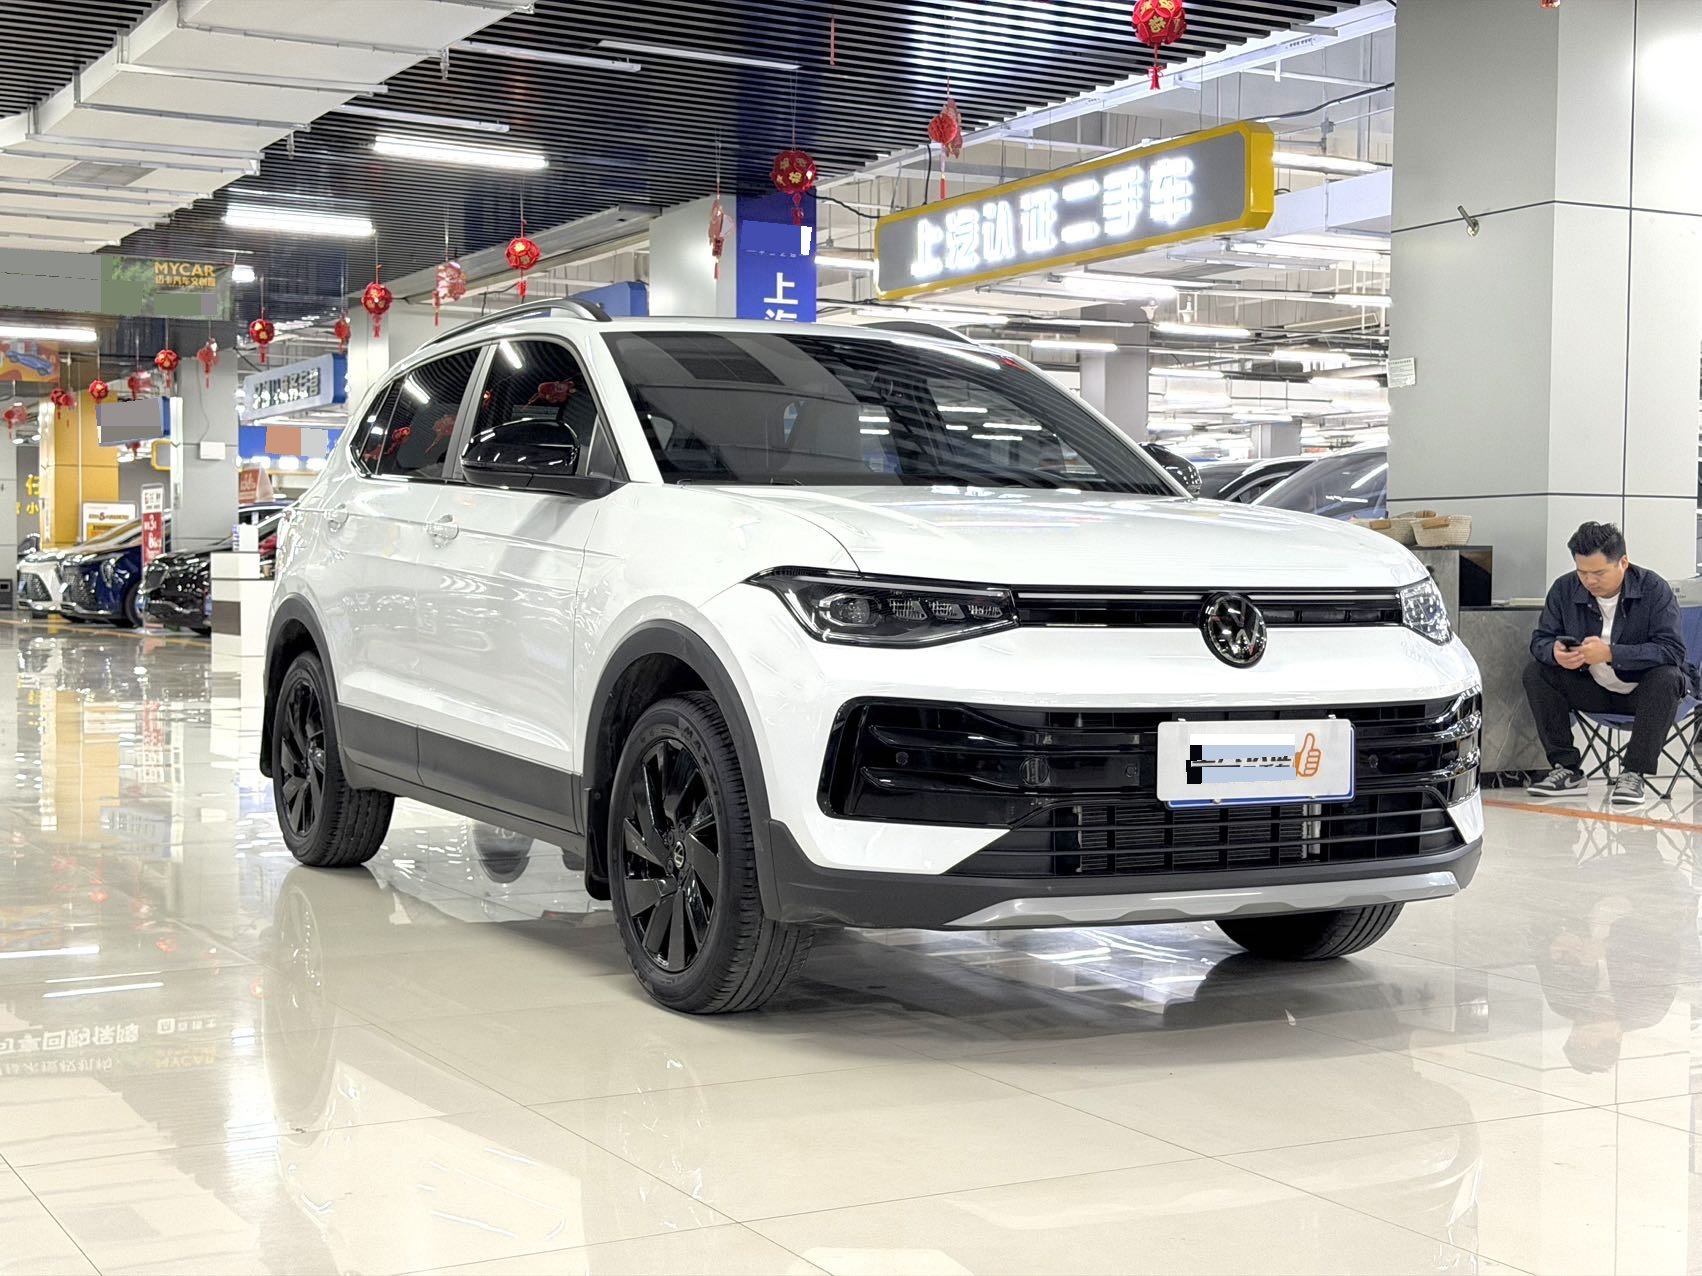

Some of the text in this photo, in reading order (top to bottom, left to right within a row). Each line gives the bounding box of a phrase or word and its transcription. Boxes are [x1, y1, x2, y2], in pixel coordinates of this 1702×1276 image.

[911, 155, 1195, 279] 上汽认证二手车
[154, 261, 216, 277] MYCAR
